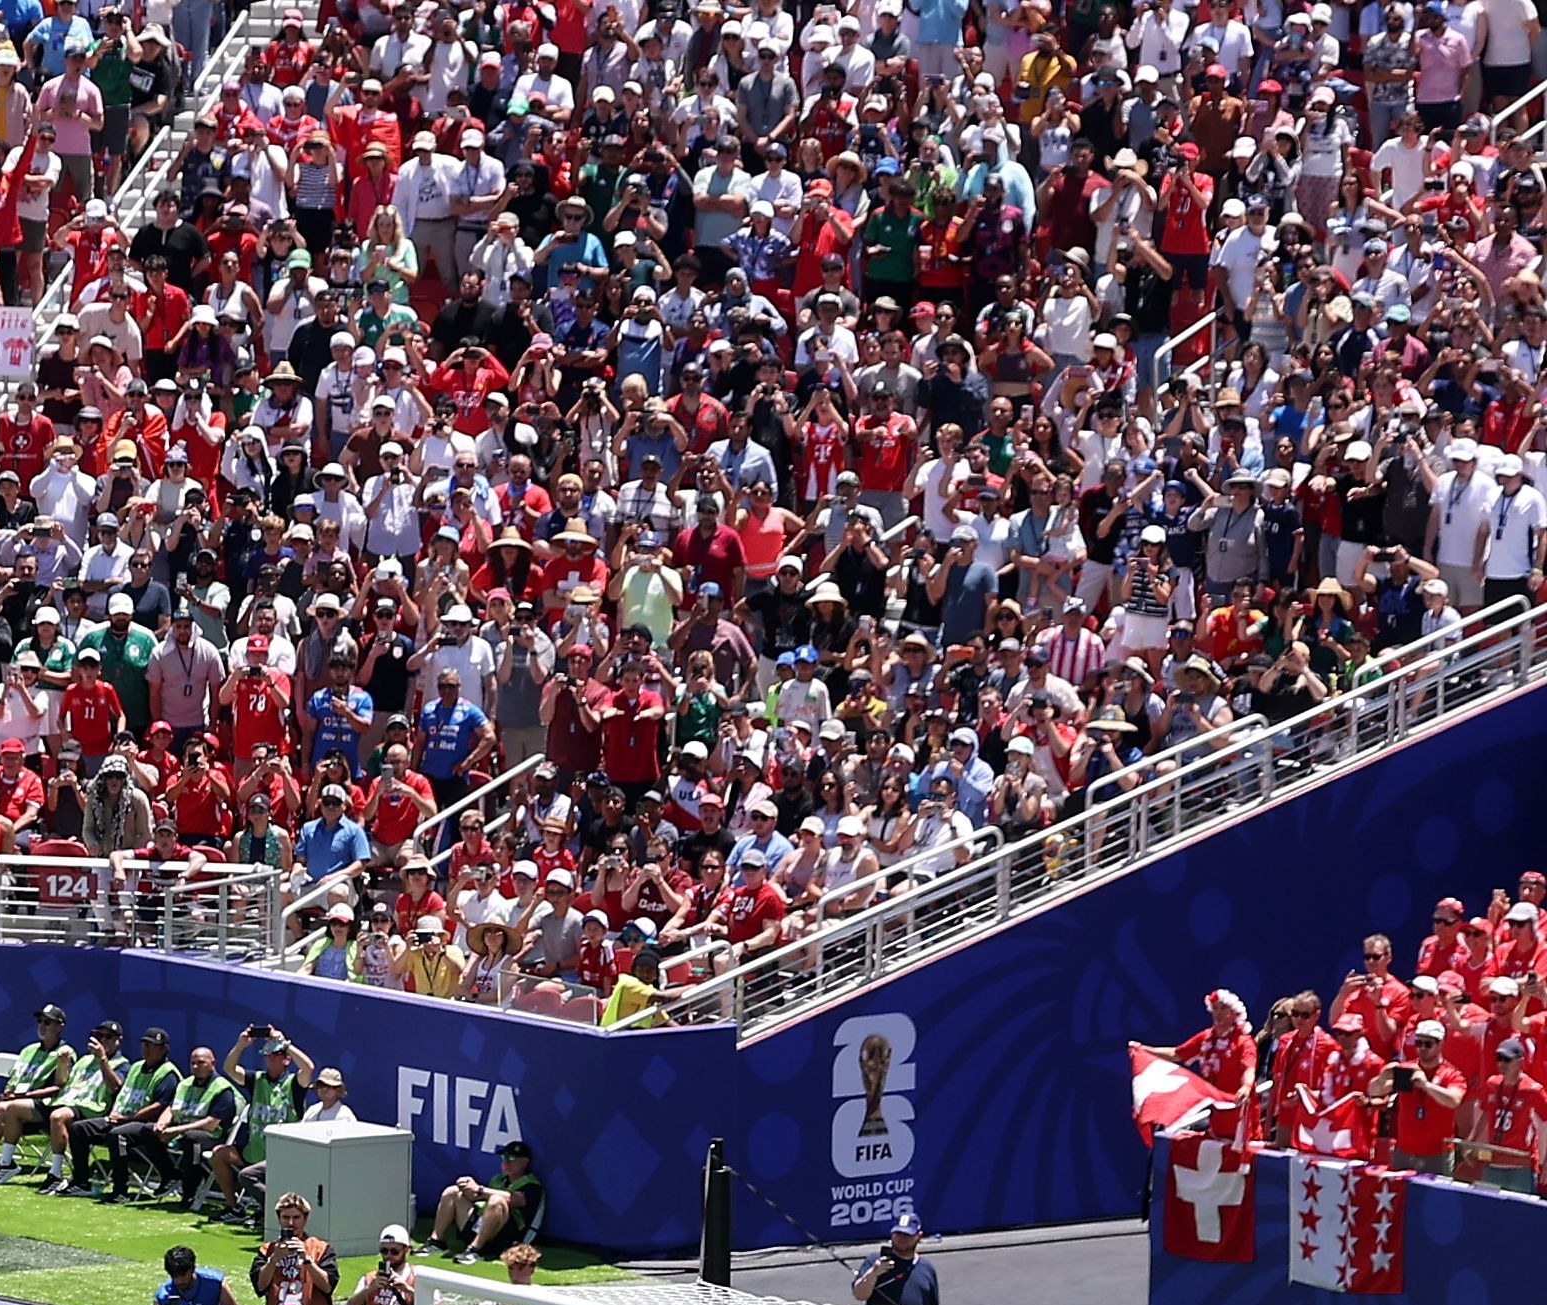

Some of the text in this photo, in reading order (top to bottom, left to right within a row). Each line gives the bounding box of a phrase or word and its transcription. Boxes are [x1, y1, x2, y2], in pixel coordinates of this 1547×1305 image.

[46, 874, 91, 898] 124
[396, 1065, 523, 1154] FIFA
[855, 1142, 893, 1162] FIFA
[831, 1178, 915, 1201] WORLD CUP
[830, 1195, 915, 1227] 2026
